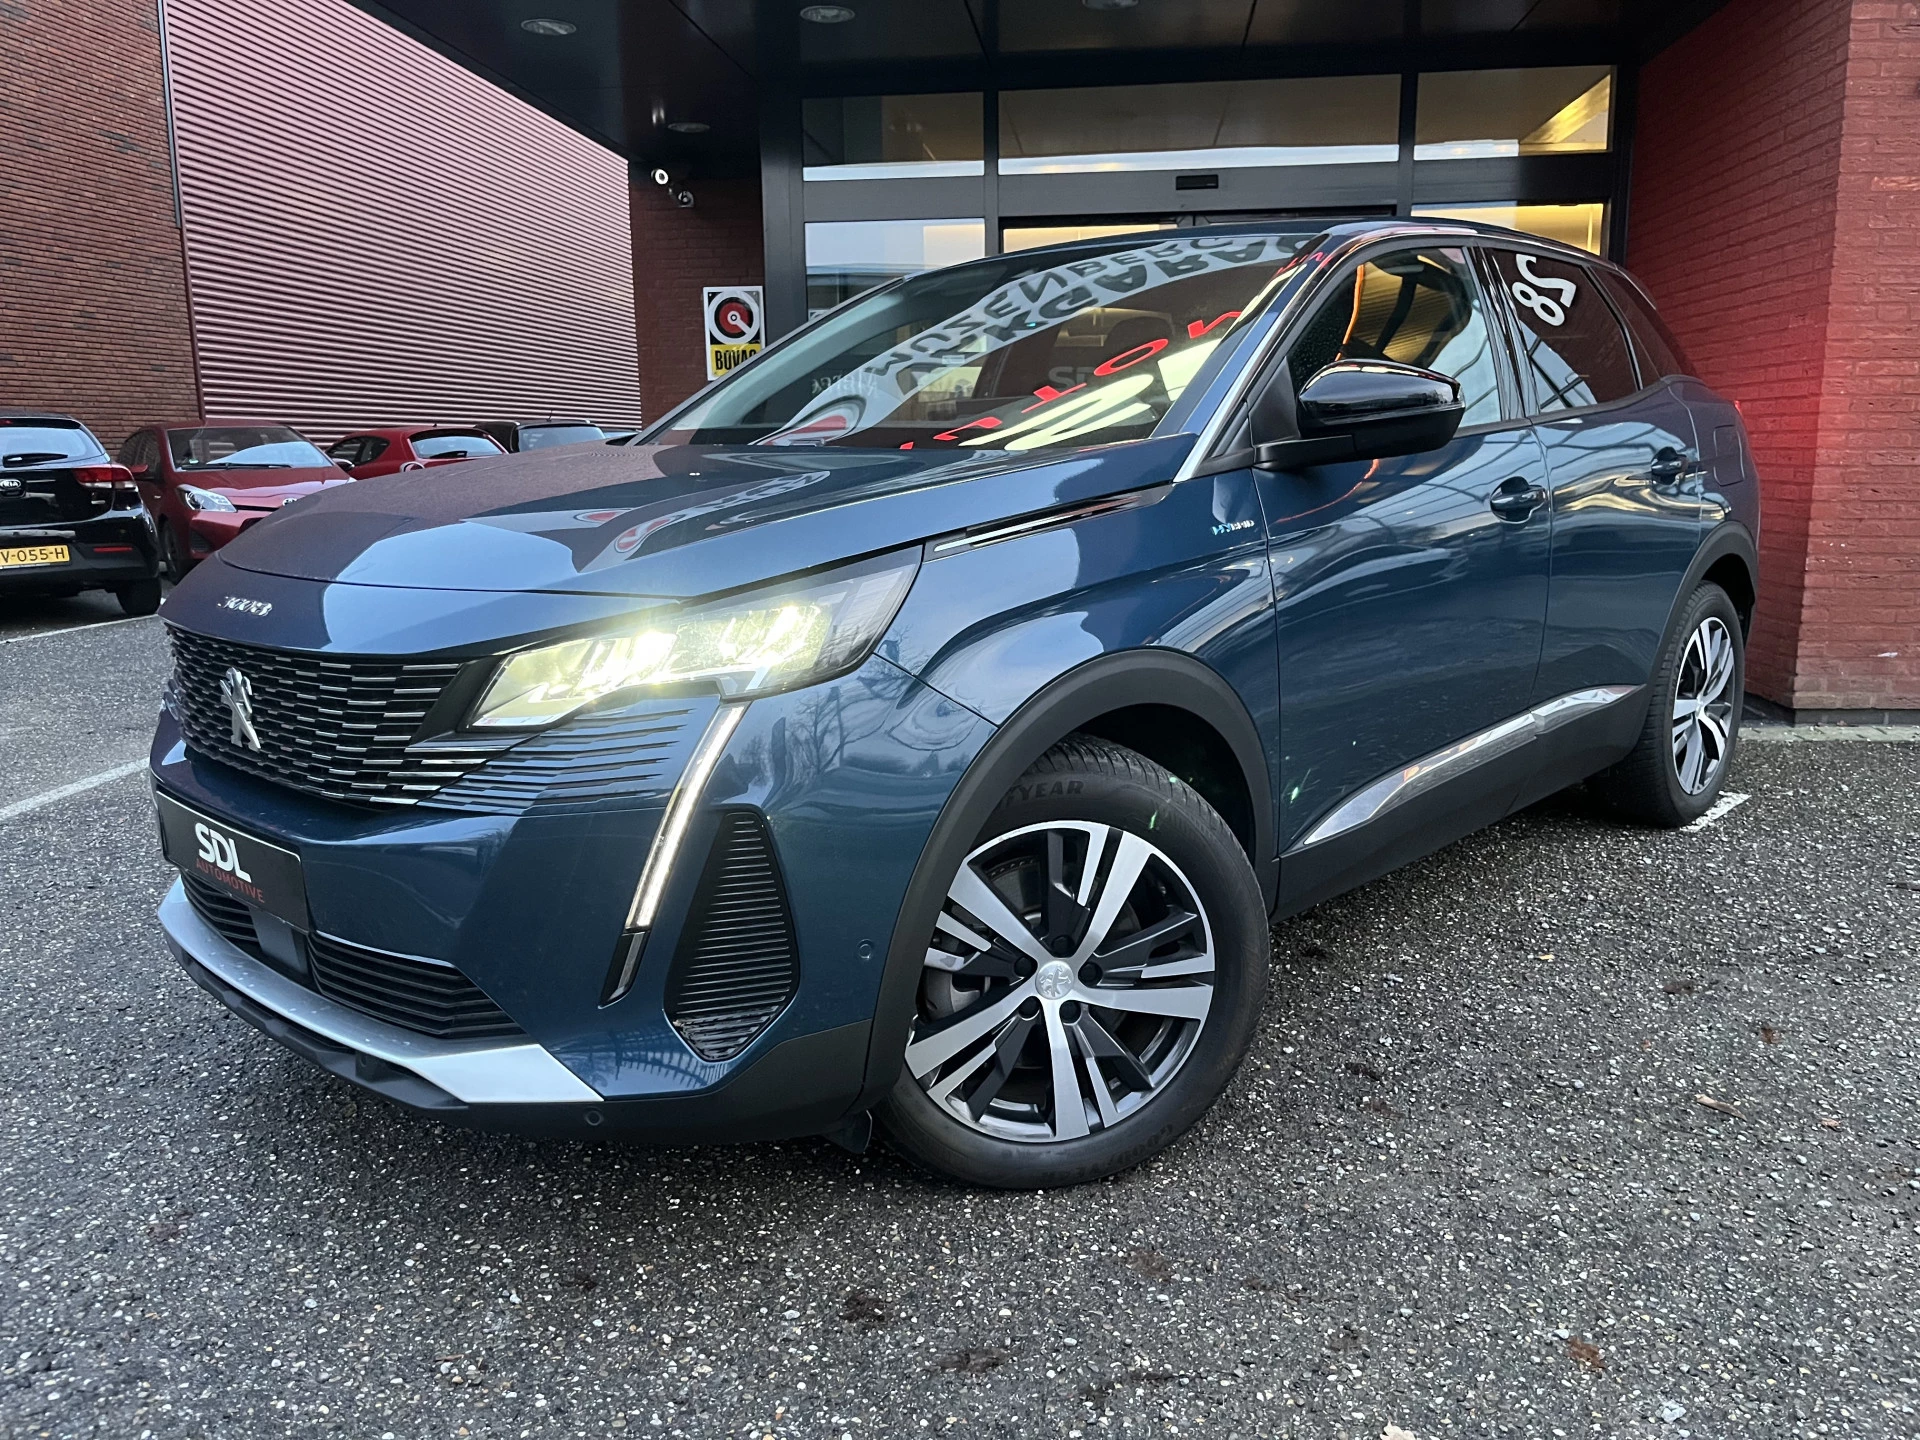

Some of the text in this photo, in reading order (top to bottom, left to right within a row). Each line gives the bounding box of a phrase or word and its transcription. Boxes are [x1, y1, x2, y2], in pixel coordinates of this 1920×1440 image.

[0, 547, 66, 564] V-055-H
[194, 822, 252, 883] SDL
[196, 858, 265, 904] AUTOMOTIVE
